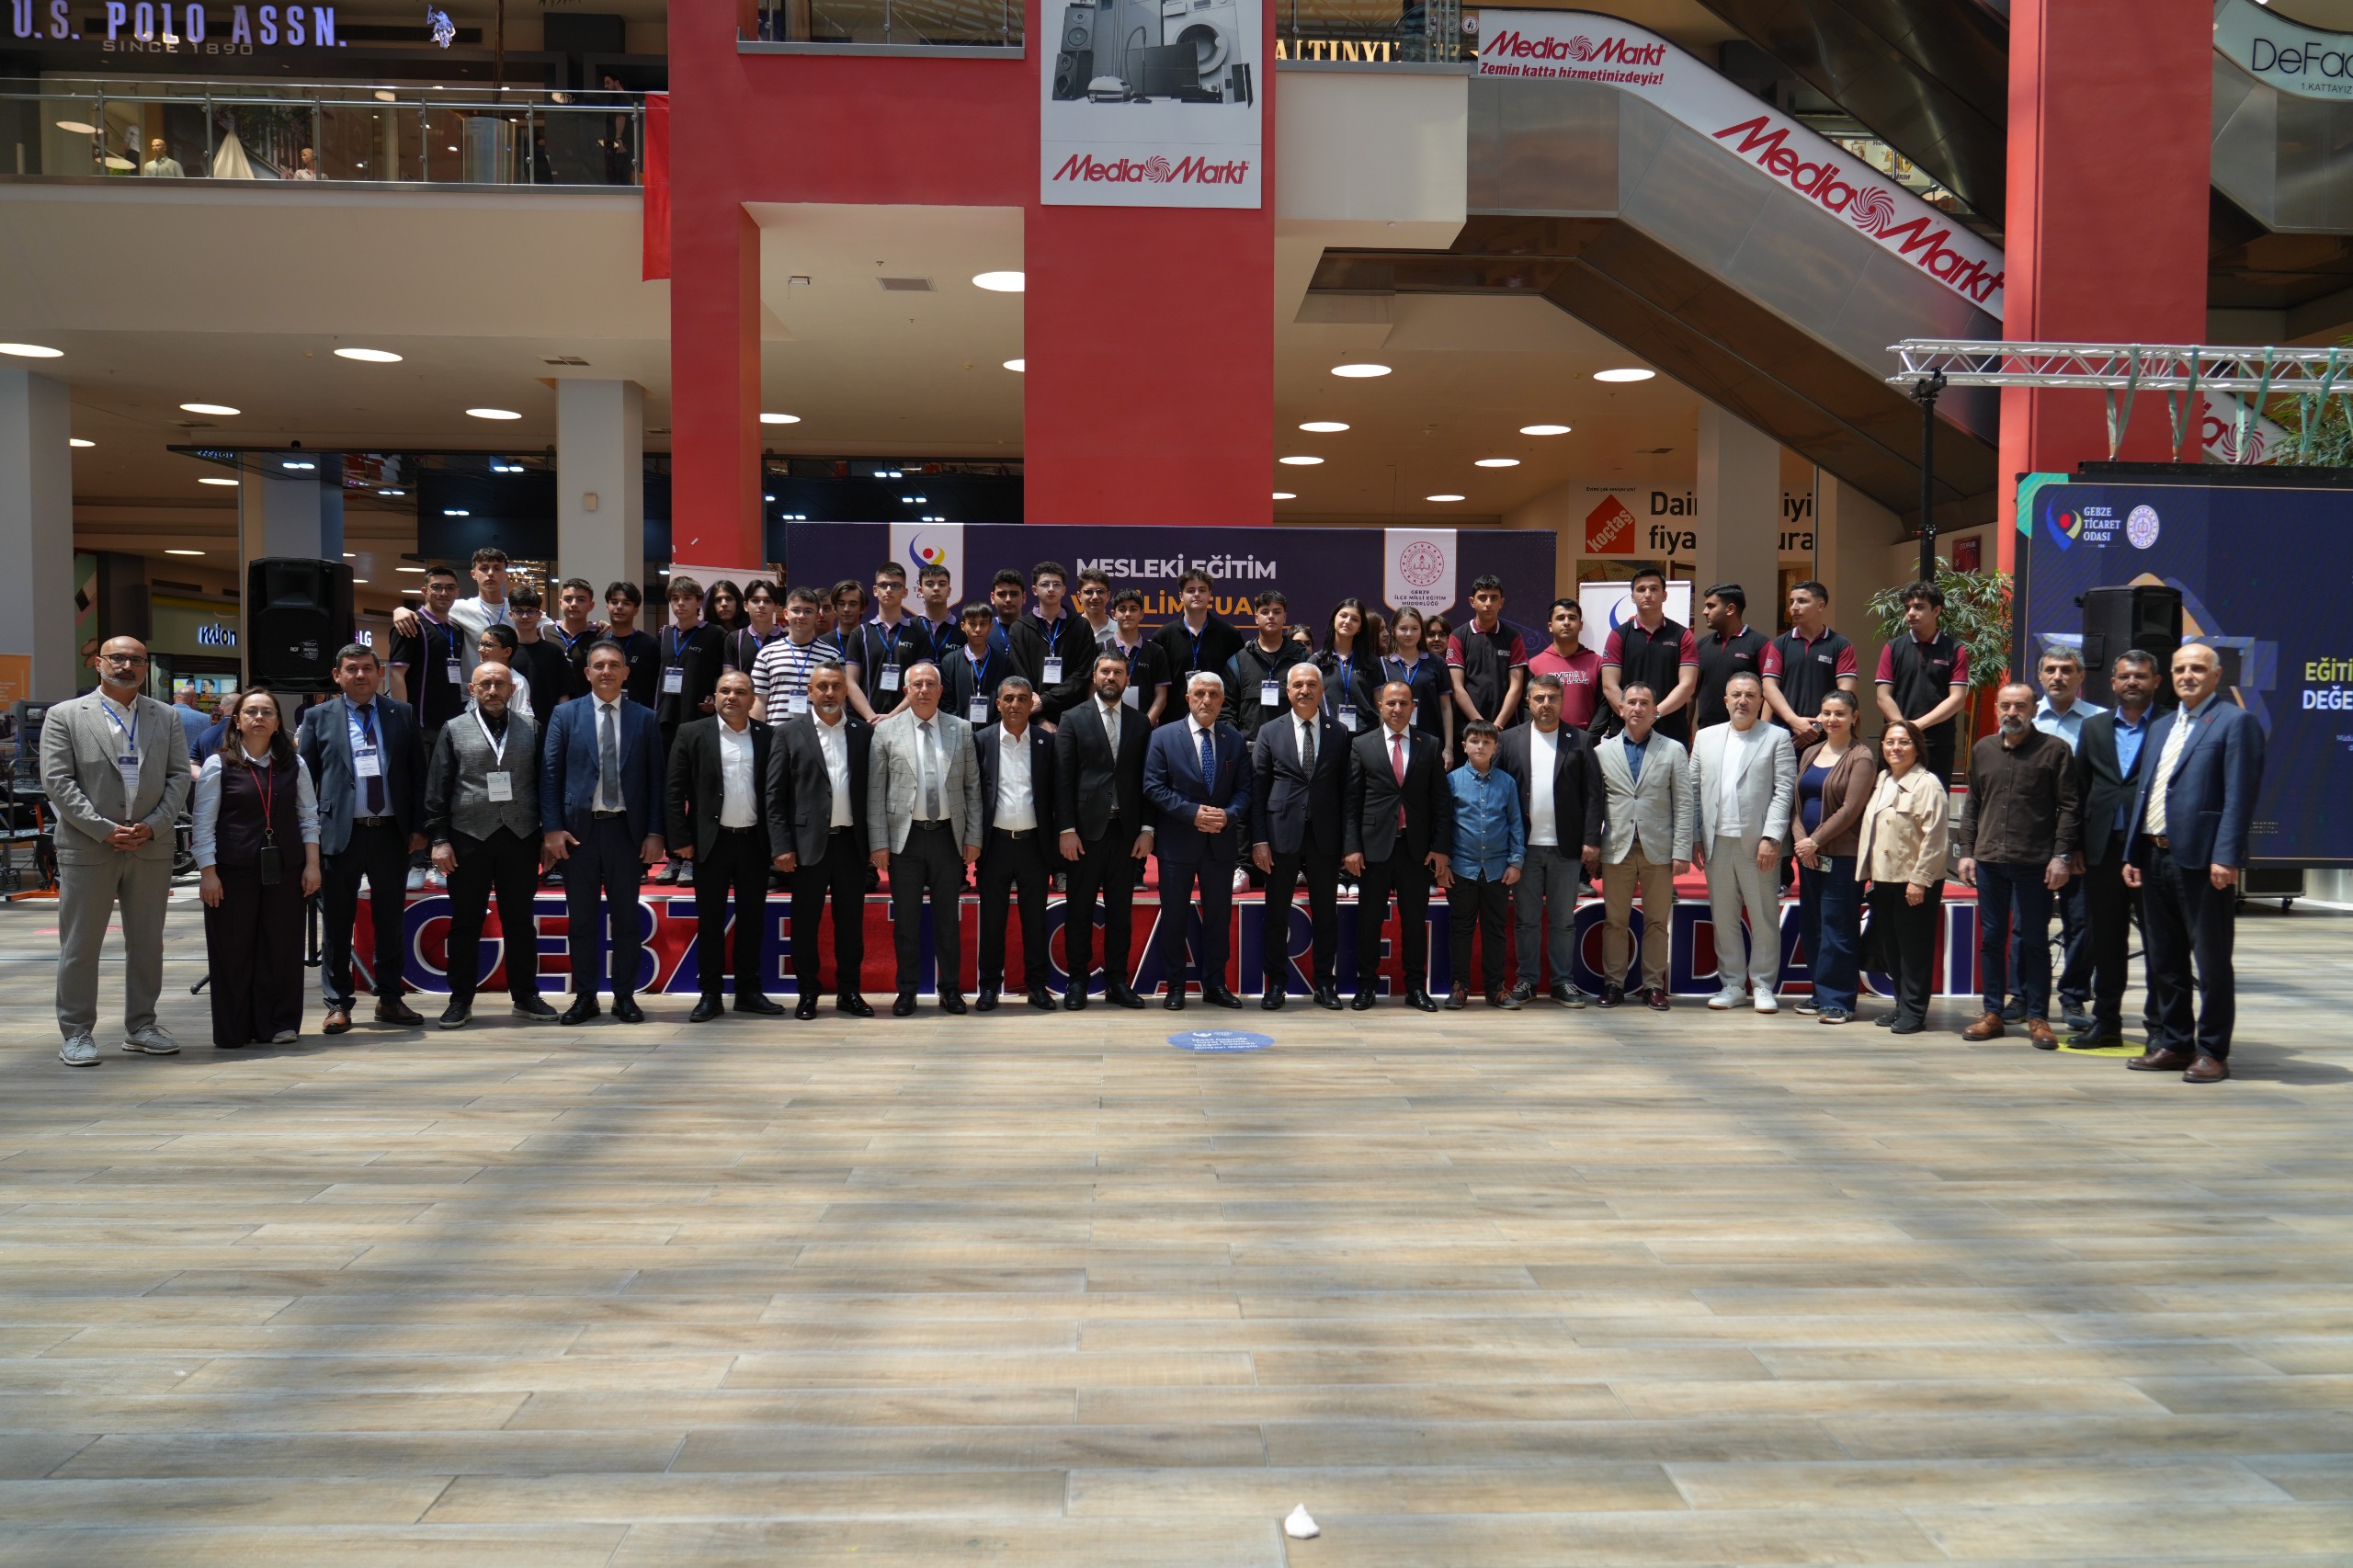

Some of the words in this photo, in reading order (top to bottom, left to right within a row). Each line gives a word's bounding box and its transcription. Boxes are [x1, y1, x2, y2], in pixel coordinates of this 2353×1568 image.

[12, 0, 80, 40] U.S.
[106, 2, 206, 44] POLO
[232, 6, 347, 47] ASSN.
[103, 40, 178, 53] SINCE
[193, 44, 253, 55] 1890
[1480, 62, 1519, 75] Zemin
[1522, 64, 1555, 77] katta
[1559, 67, 1664, 86] hizmetinizdeyiz!
[2084, 506, 2112, 517] GEBZE
[2084, 517, 2120, 528] TİCARET
[1586, 509, 1634, 552] koçtaş
[2084, 532, 2110, 540] ODASI
[1077, 554, 1184, 577] MESLEKİ
[1191, 554, 1276, 579] EĞİTİM
[199, 623, 236, 645] mion
[359, 631, 371, 646] LG
[1549, 670, 1588, 685] MTAL
